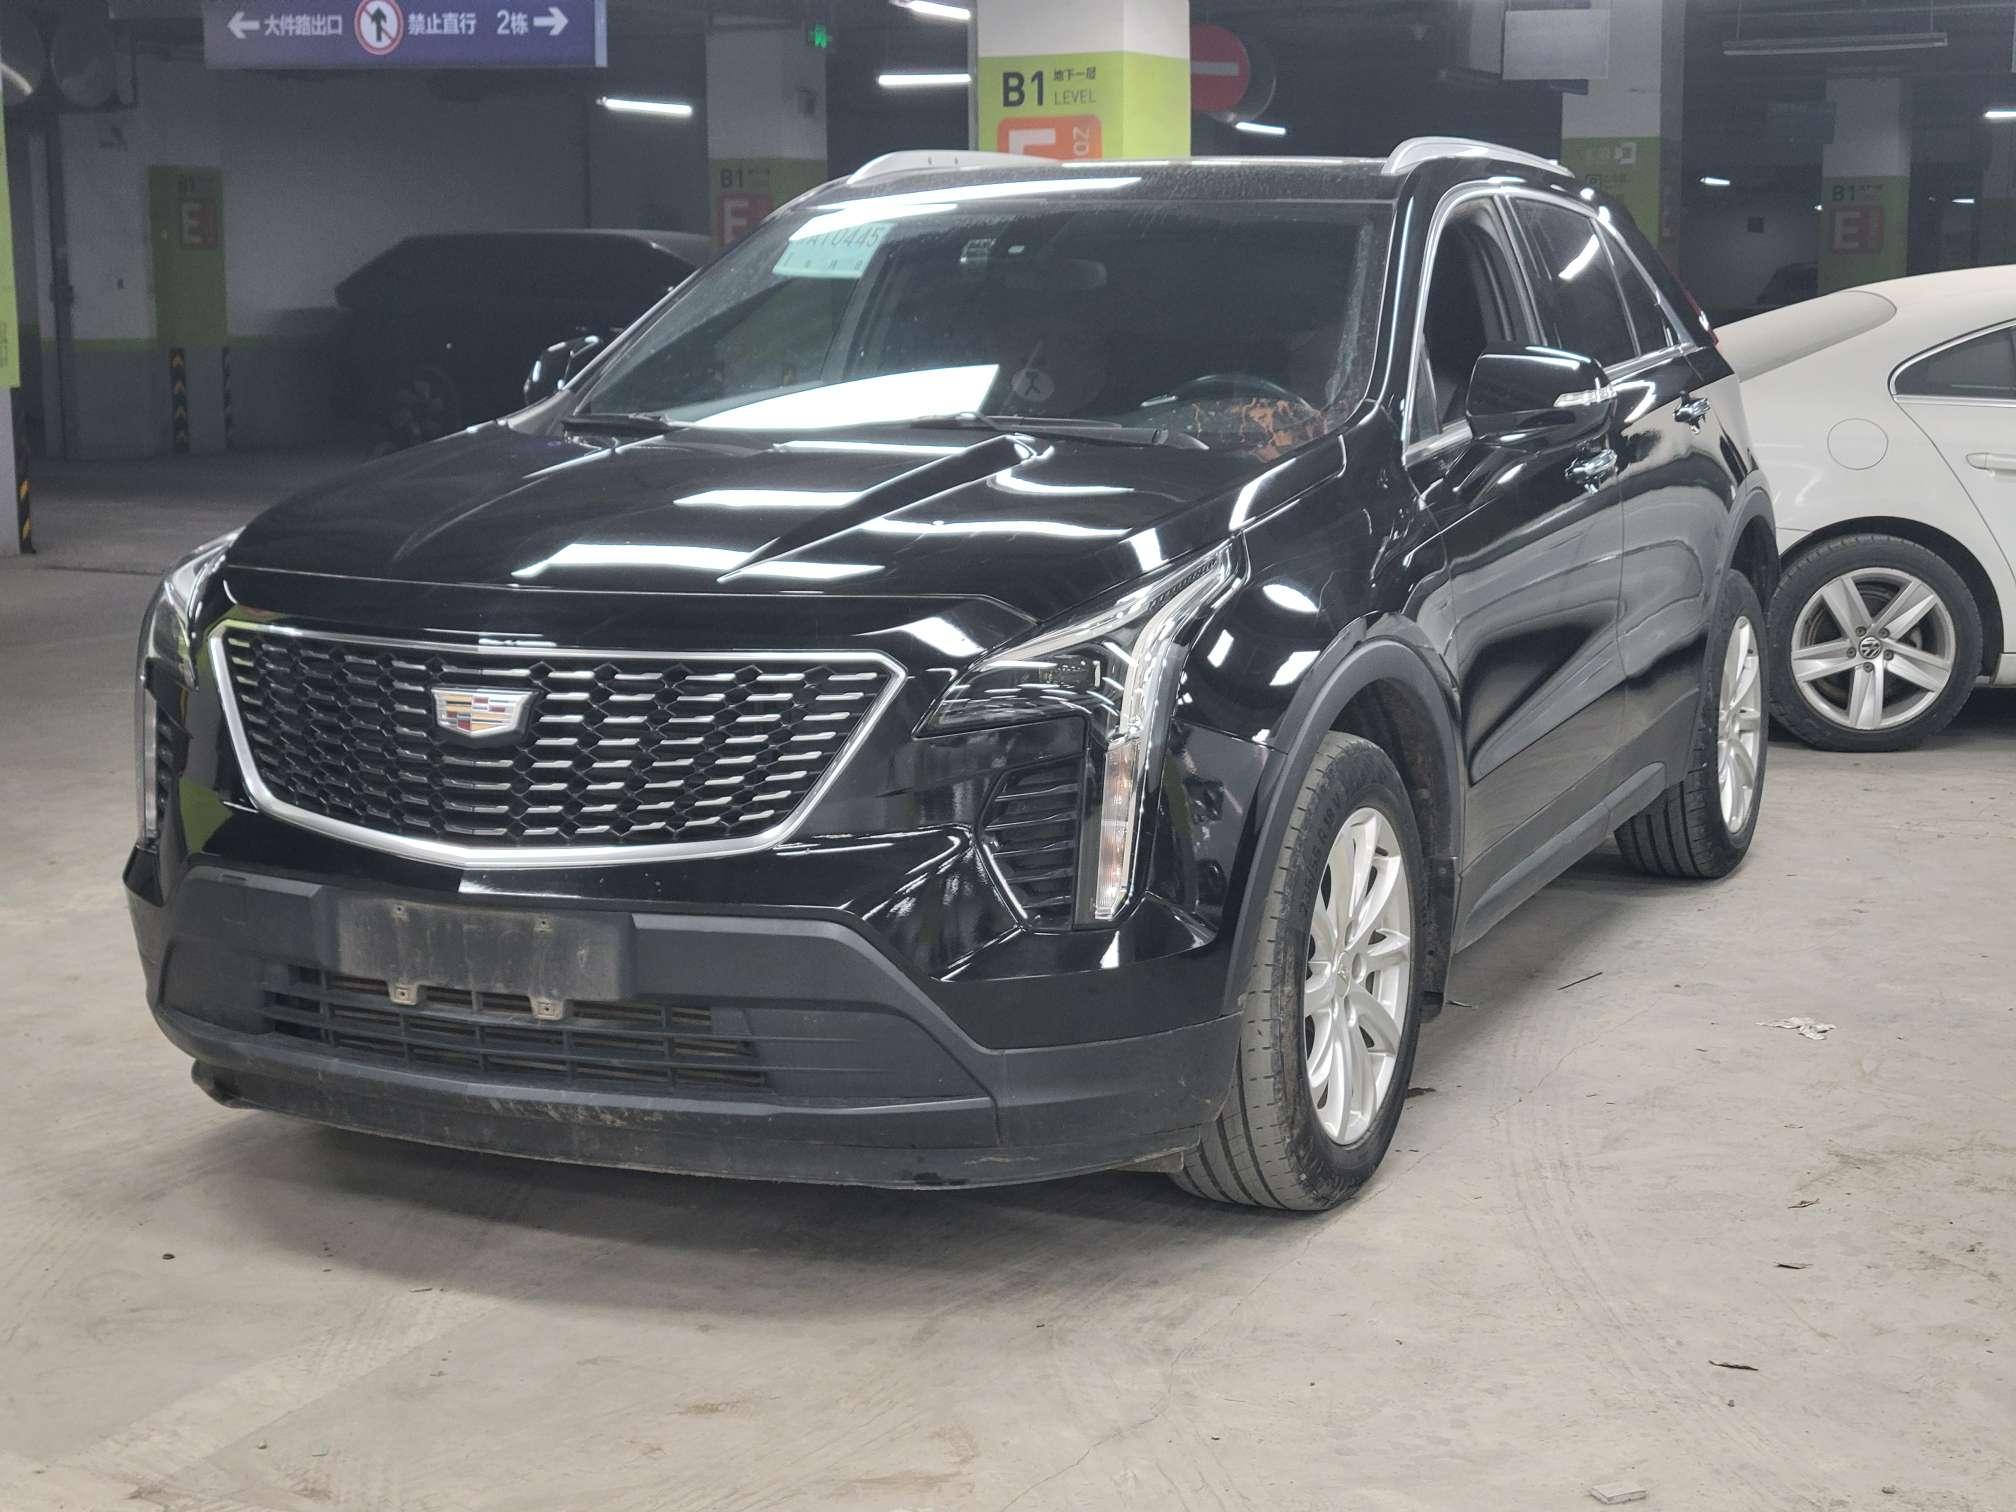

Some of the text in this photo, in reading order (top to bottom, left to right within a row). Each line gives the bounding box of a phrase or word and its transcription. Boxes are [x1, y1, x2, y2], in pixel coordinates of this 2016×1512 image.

[408, 13, 477, 36] 禁止直行
[496, 10, 529, 35] 2栋
[1002, 70, 1044, 107] B1
[1054, 88, 1096, 105] LEVEL
[720, 168, 743, 188] B1
[1832, 184, 1855, 201] B1
[1836, 210, 1861, 248] E
